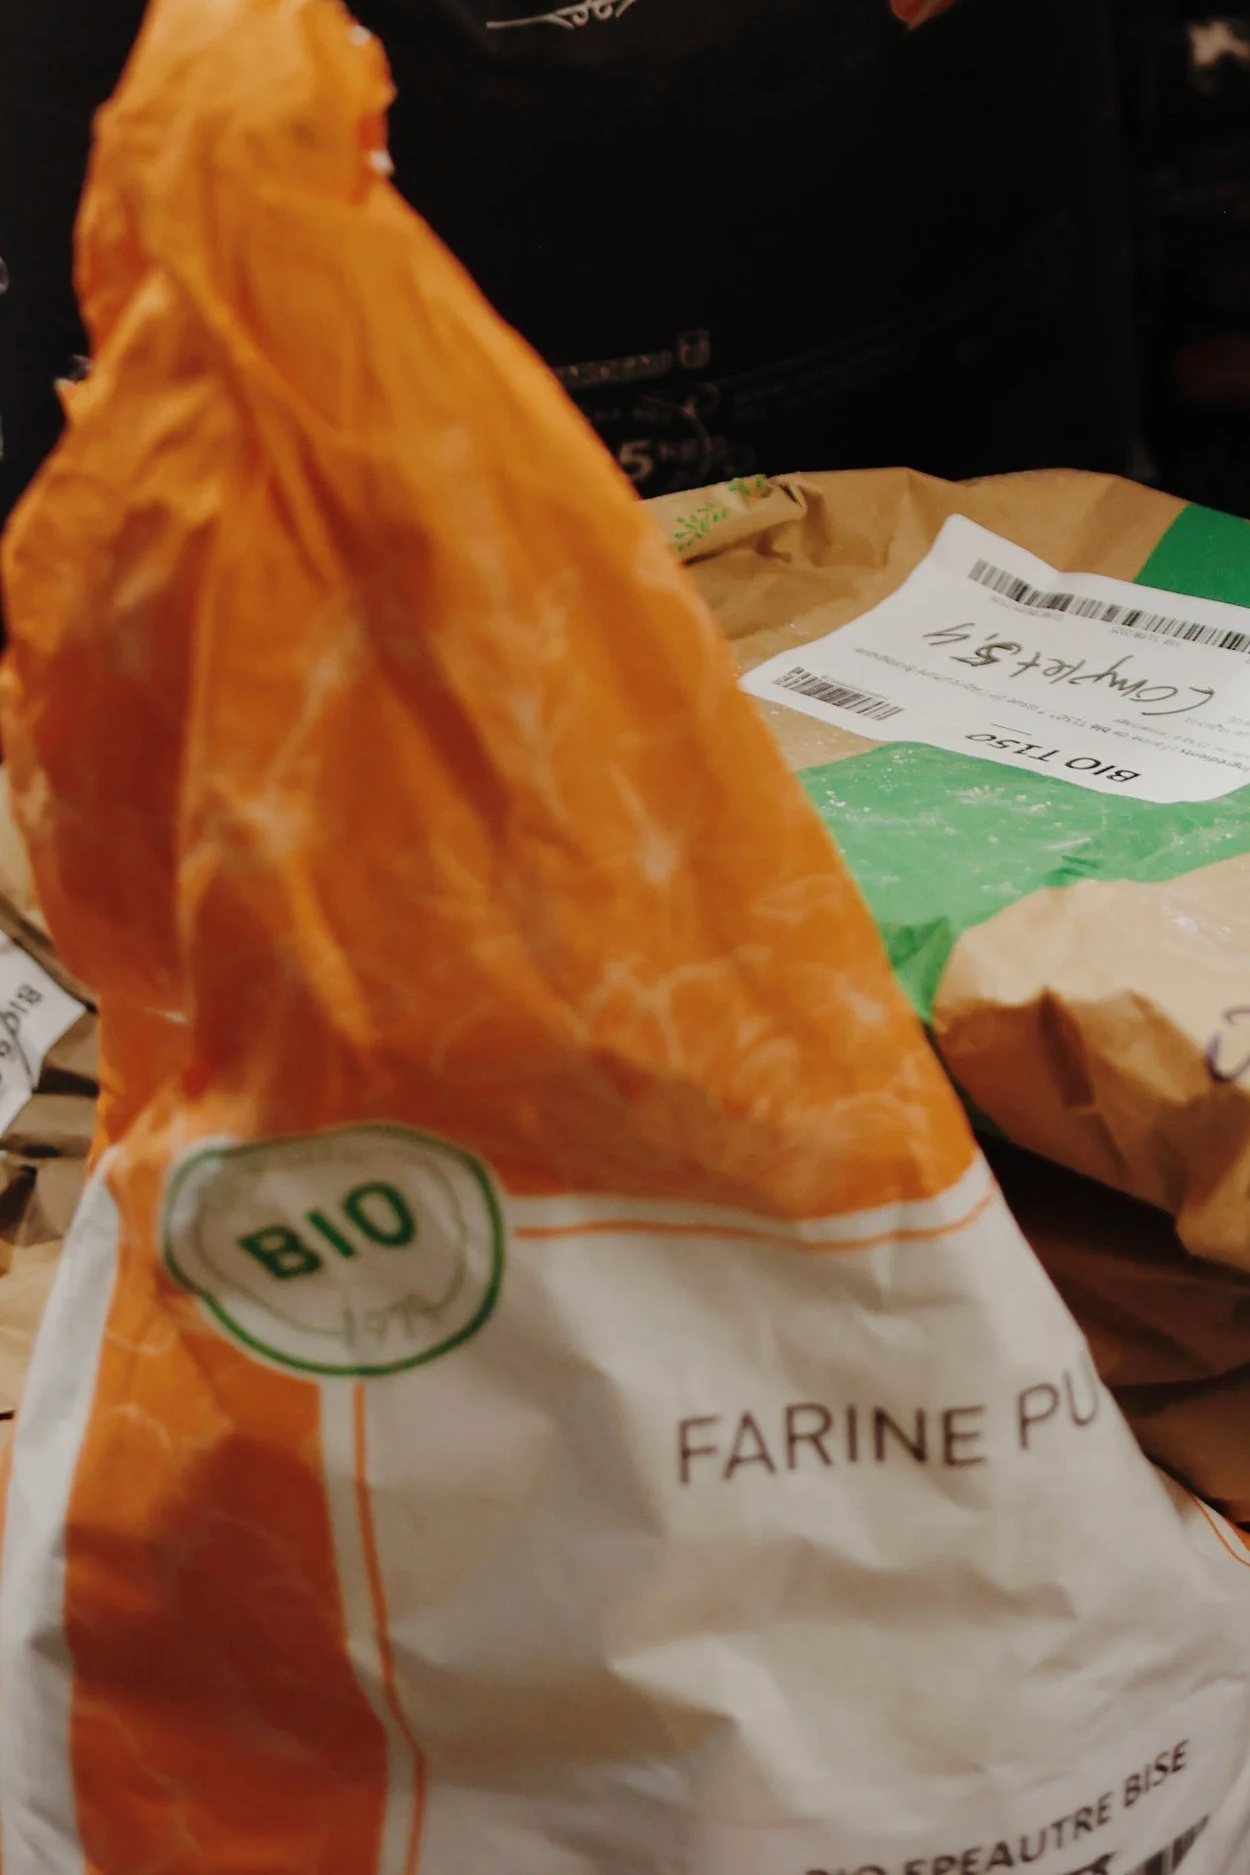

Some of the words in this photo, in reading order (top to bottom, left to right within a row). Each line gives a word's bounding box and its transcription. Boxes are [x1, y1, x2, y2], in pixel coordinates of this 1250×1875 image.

[965, 732, 1060, 765] T150
[1062, 755, 1141, 784] BIO
[238, 1179, 418, 1282] BIO
[676, 1401, 991, 1488] FARINE
[1120, 1738, 1190, 1808] BISE
